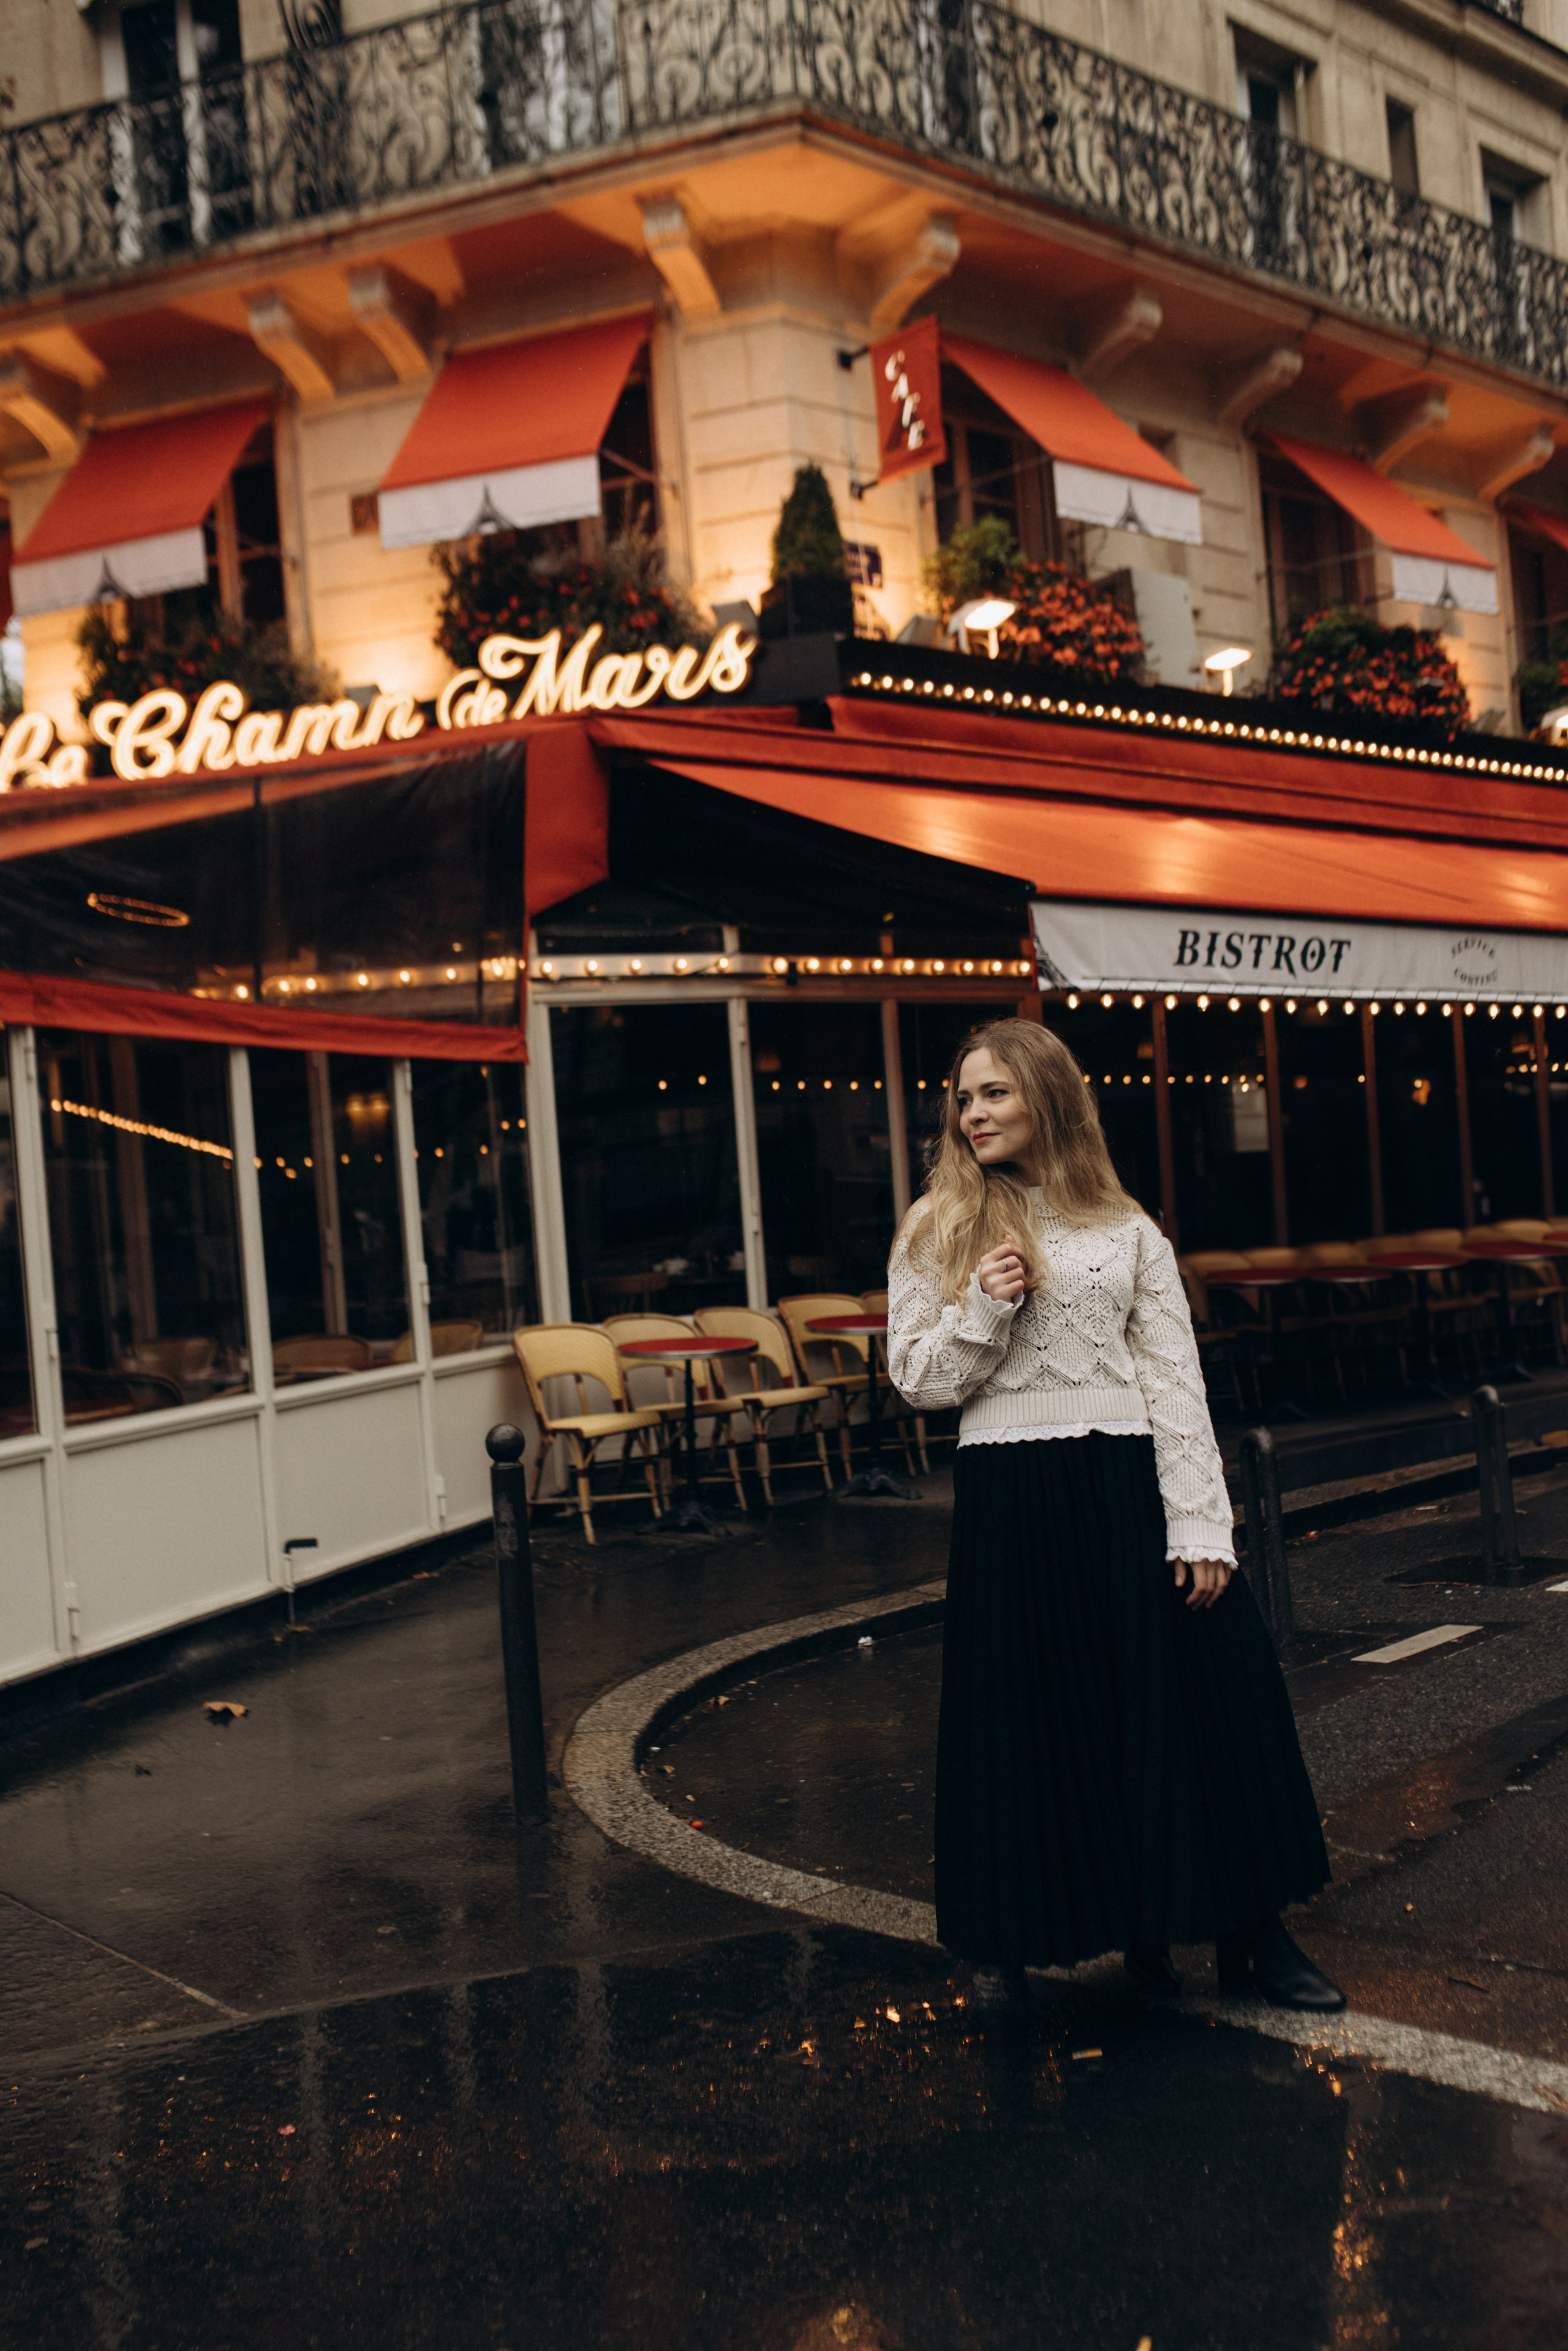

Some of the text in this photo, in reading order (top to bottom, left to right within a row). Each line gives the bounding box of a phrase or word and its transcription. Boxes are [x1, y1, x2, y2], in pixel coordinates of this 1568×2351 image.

[436, 669, 508, 730] de
[477, 623, 758, 720] Mars
[1173, 929, 1351, 979] BISTROT
